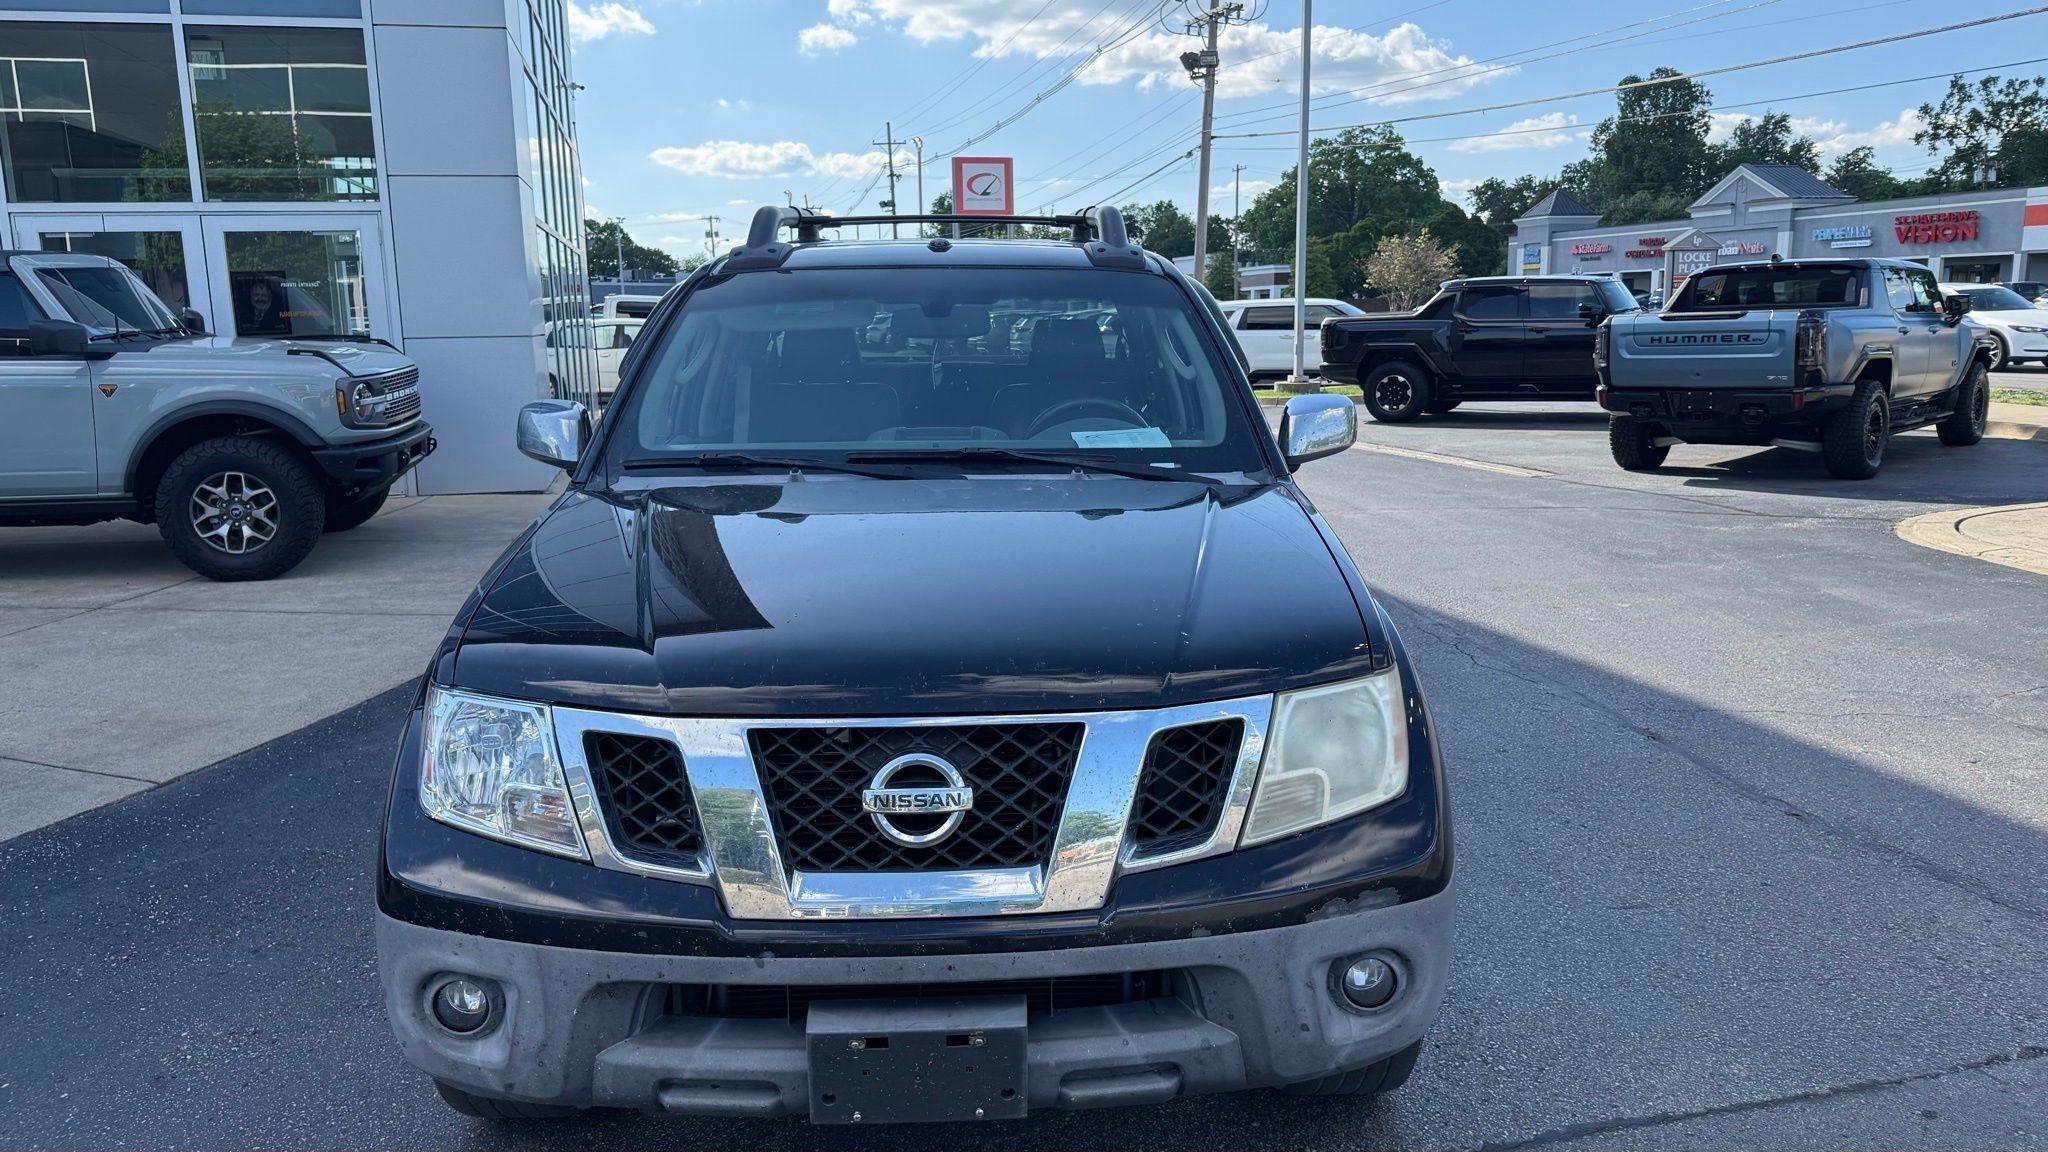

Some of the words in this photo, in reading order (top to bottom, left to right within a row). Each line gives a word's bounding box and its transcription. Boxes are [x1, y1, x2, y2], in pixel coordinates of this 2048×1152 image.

[1894, 222, 1978, 245] VISION
[1740, 240, 1764, 254] Nails
[1678, 252, 1712, 262] LOCKE
[1650, 334, 1751, 344] HUMMER
[872, 792, 963, 808] NISSAN
